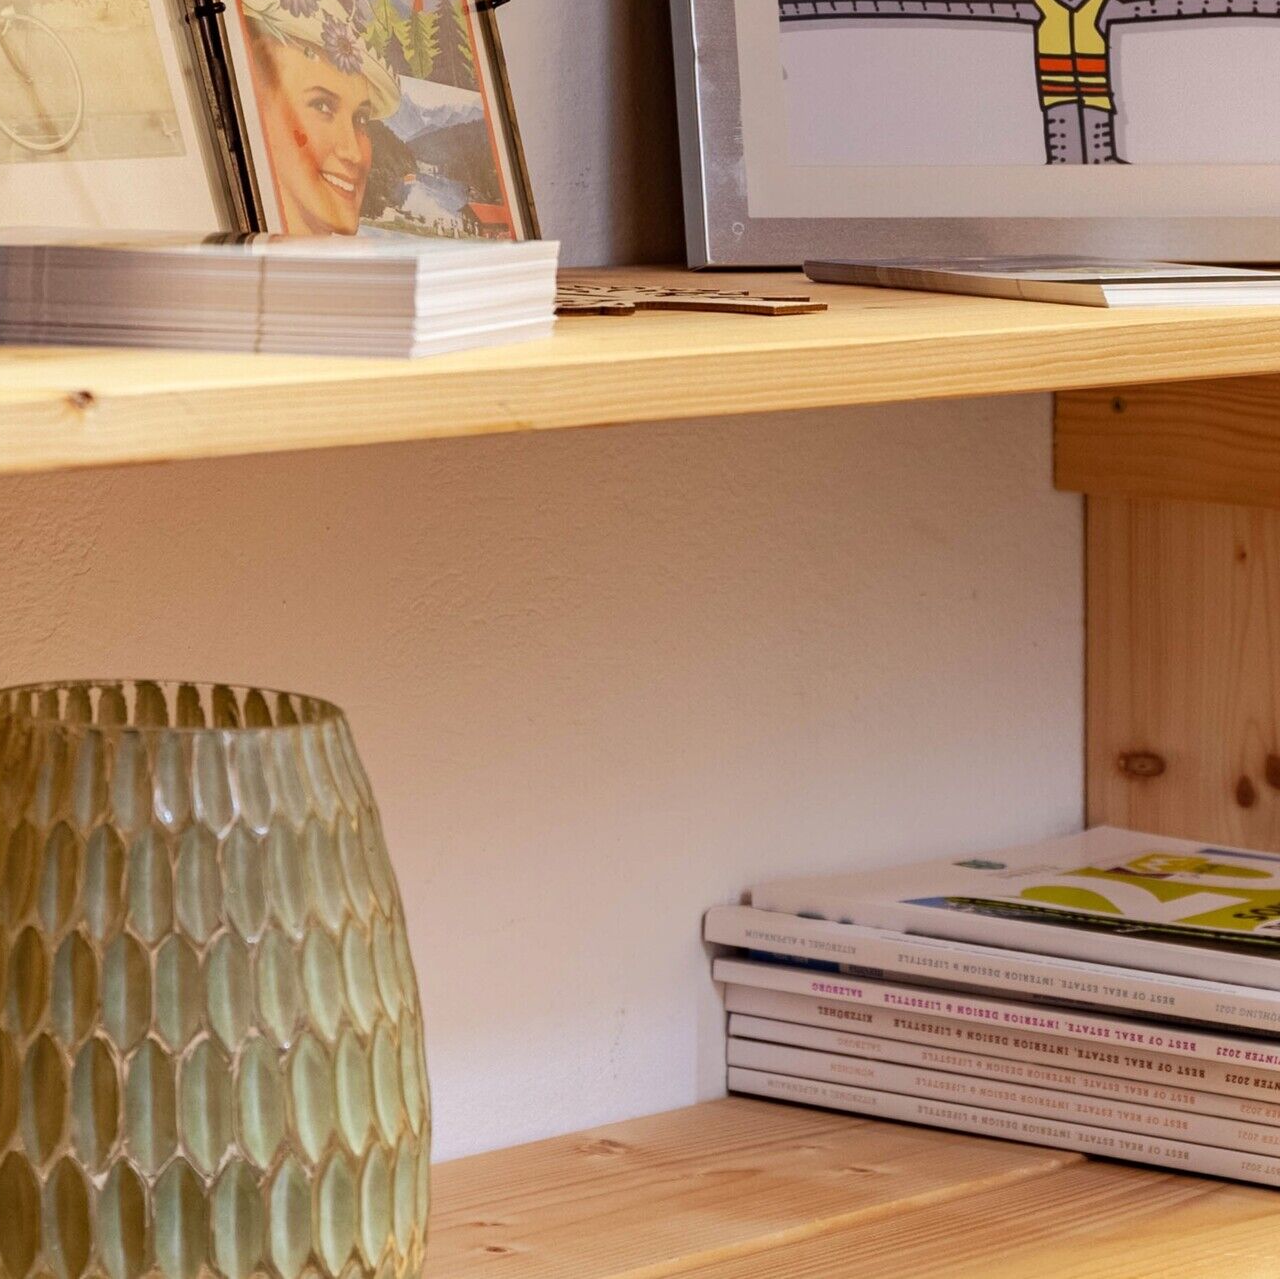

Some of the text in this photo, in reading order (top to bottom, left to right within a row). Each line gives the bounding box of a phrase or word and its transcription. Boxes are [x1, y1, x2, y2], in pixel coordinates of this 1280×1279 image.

[744, 928, 798, 944] ALPENRAUM
[898, 954, 950, 970] LIFESTYLE
[962, 964, 1000, 978] DESIGN
[1004, 970, 1054, 988] INTERIOR
[811, 982, 863, 998] SALZBURG
[1102, 986, 1128, 998] REAL
[1132, 990, 1146, 1000] OF
[884, 993, 942, 1011] LIFESTYLE
[1150, 992, 1176, 1006] BEST
[817, 1005, 874, 1024] KITZBÜHEL
[956, 1005, 1000, 1020] DESIGN
[1216, 1004, 1236, 1014] 2021
[893, 1018, 952, 1036] LIFESTYLE
[1003, 1012, 1060, 1030] INTERIOR
[967, 1030, 1009, 1046] DESIGN
[1114, 1030, 1144, 1044] REAL
[1148, 1036, 1164, 1046] OF
[1013, 1038, 1070, 1056] INTERIOR
[1168, 1038, 1198, 1052] BEST
[1216, 1046, 1241, 1058] 2023
[921, 1051, 972, 1068] LIFESTYLE
[1124, 1056, 1154, 1070] REAL
[986, 1062, 1024, 1076] DESIGN
[1157, 1062, 1172, 1074] OF
[1176, 1064, 1206, 1078] BEST
[1026, 1068, 1076, 1084] INTERIOR
[1224, 1073, 1250, 1086] 2023
[916, 1076, 967, 1094] LIFESTYLE
[1124, 1084, 1150, 1098] REAL
[980, 1088, 1018, 1102] DESIGN
[1152, 1090, 1166, 1100] OF
[1170, 1092, 1196, 1104] BEST
[1021, 1094, 1070, 1111] INTERIOR
[917, 1104, 968, 1122] LIFESTYLE
[1116, 1110, 1142, 1122] REAL
[1146, 1114, 1160, 1126] OF
[980, 1116, 1018, 1130] DESIGN
[1163, 1118, 1188, 1130] BEST
[1022, 1123, 1071, 1140] INTERIOR
[1118, 1139, 1144, 1152] REAL
[1148, 1144, 1160, 1156] OF
[1164, 1148, 1190, 1160] BEST
